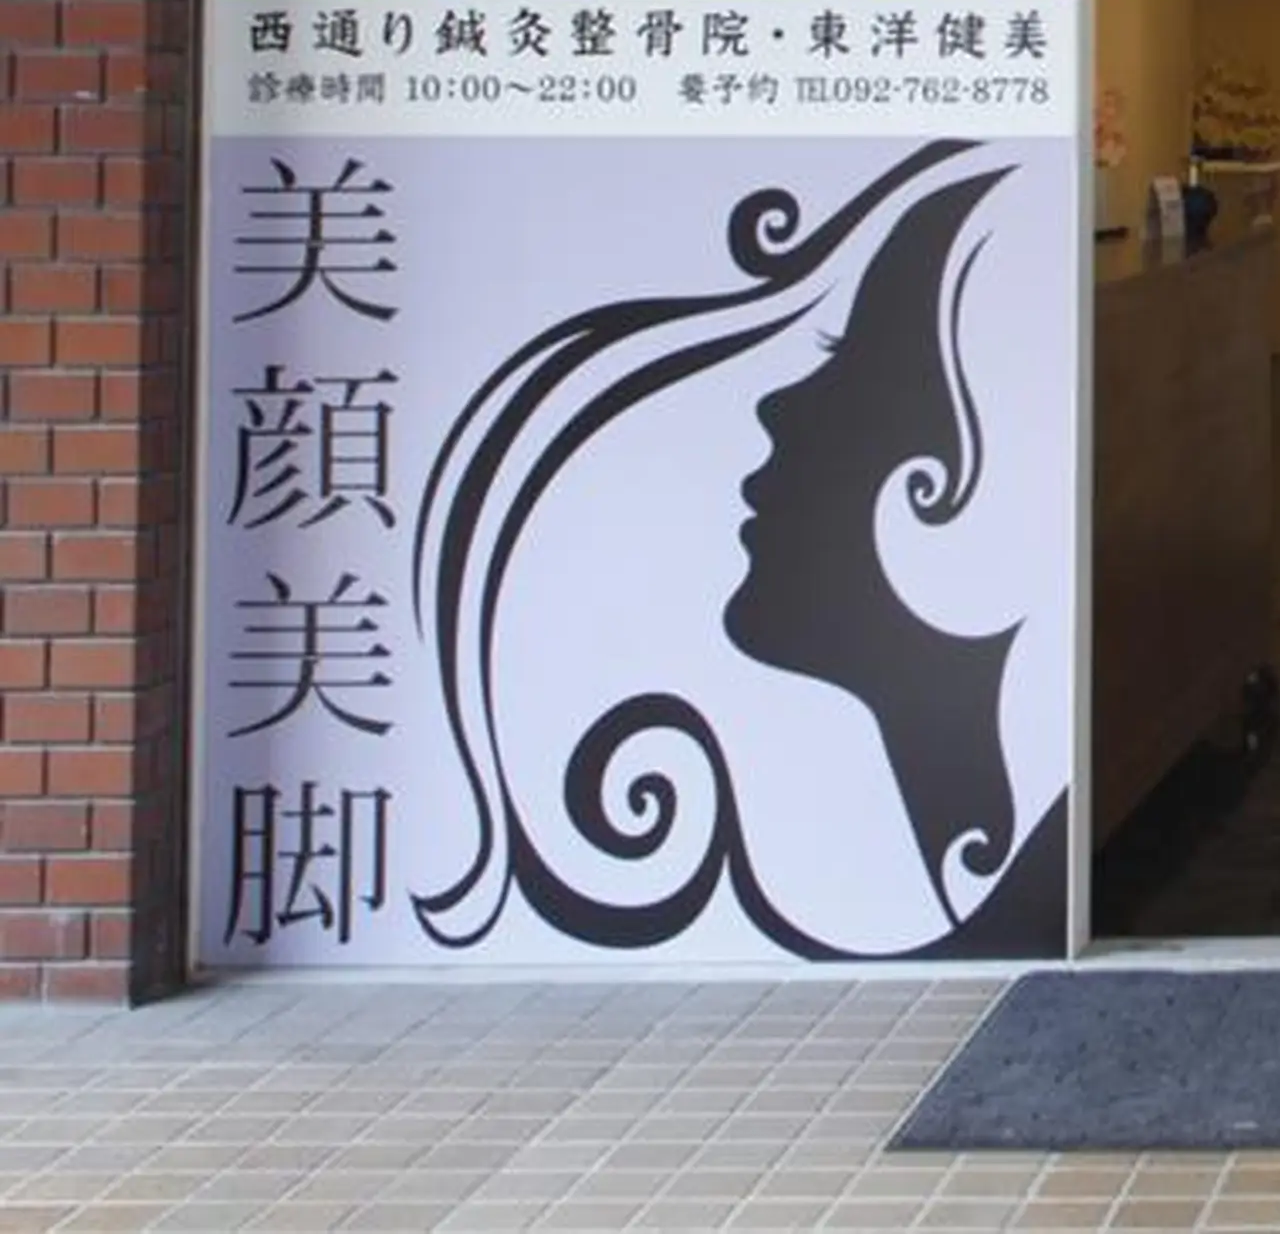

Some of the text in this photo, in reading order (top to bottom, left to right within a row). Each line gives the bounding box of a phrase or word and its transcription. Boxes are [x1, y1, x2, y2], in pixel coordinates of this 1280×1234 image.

[249, 7, 1048, 59] 西通り鍼灸整骨院・東洋健美
[247, 72, 386, 104] 診療時間
[223, 157, 399, 947] 美顔美脚
